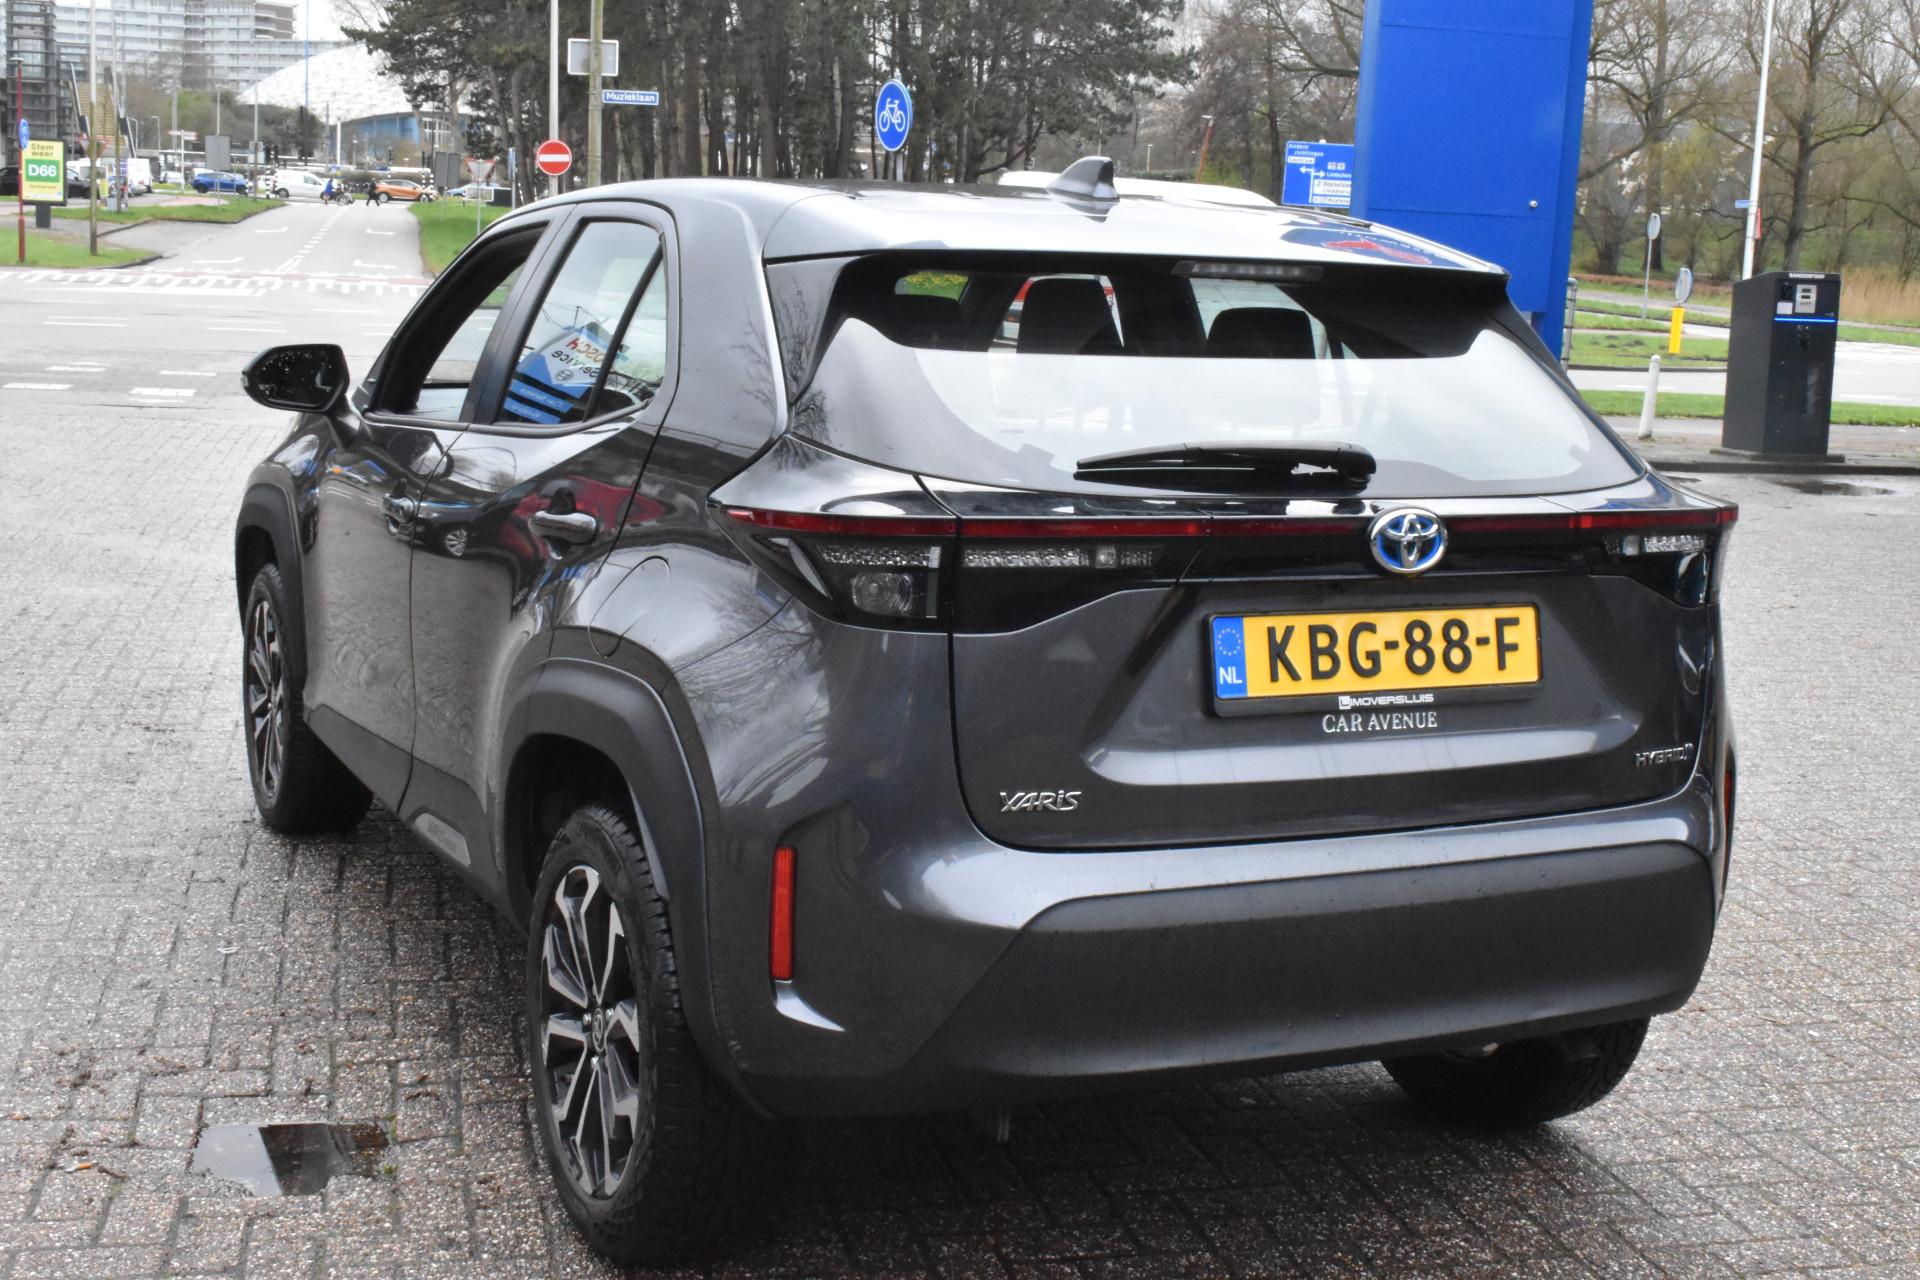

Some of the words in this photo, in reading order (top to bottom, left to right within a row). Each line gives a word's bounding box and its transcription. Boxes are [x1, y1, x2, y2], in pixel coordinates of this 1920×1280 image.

[606, 92, 655, 102] Muzieklaan
[28, 164, 57, 177] D66
[1267, 618, 1519, 682] KBG-88-F
[1219, 666, 1243, 685] NL
[1322, 713, 1363, 733] CAR
[1367, 711, 1438, 731] AVENUE
